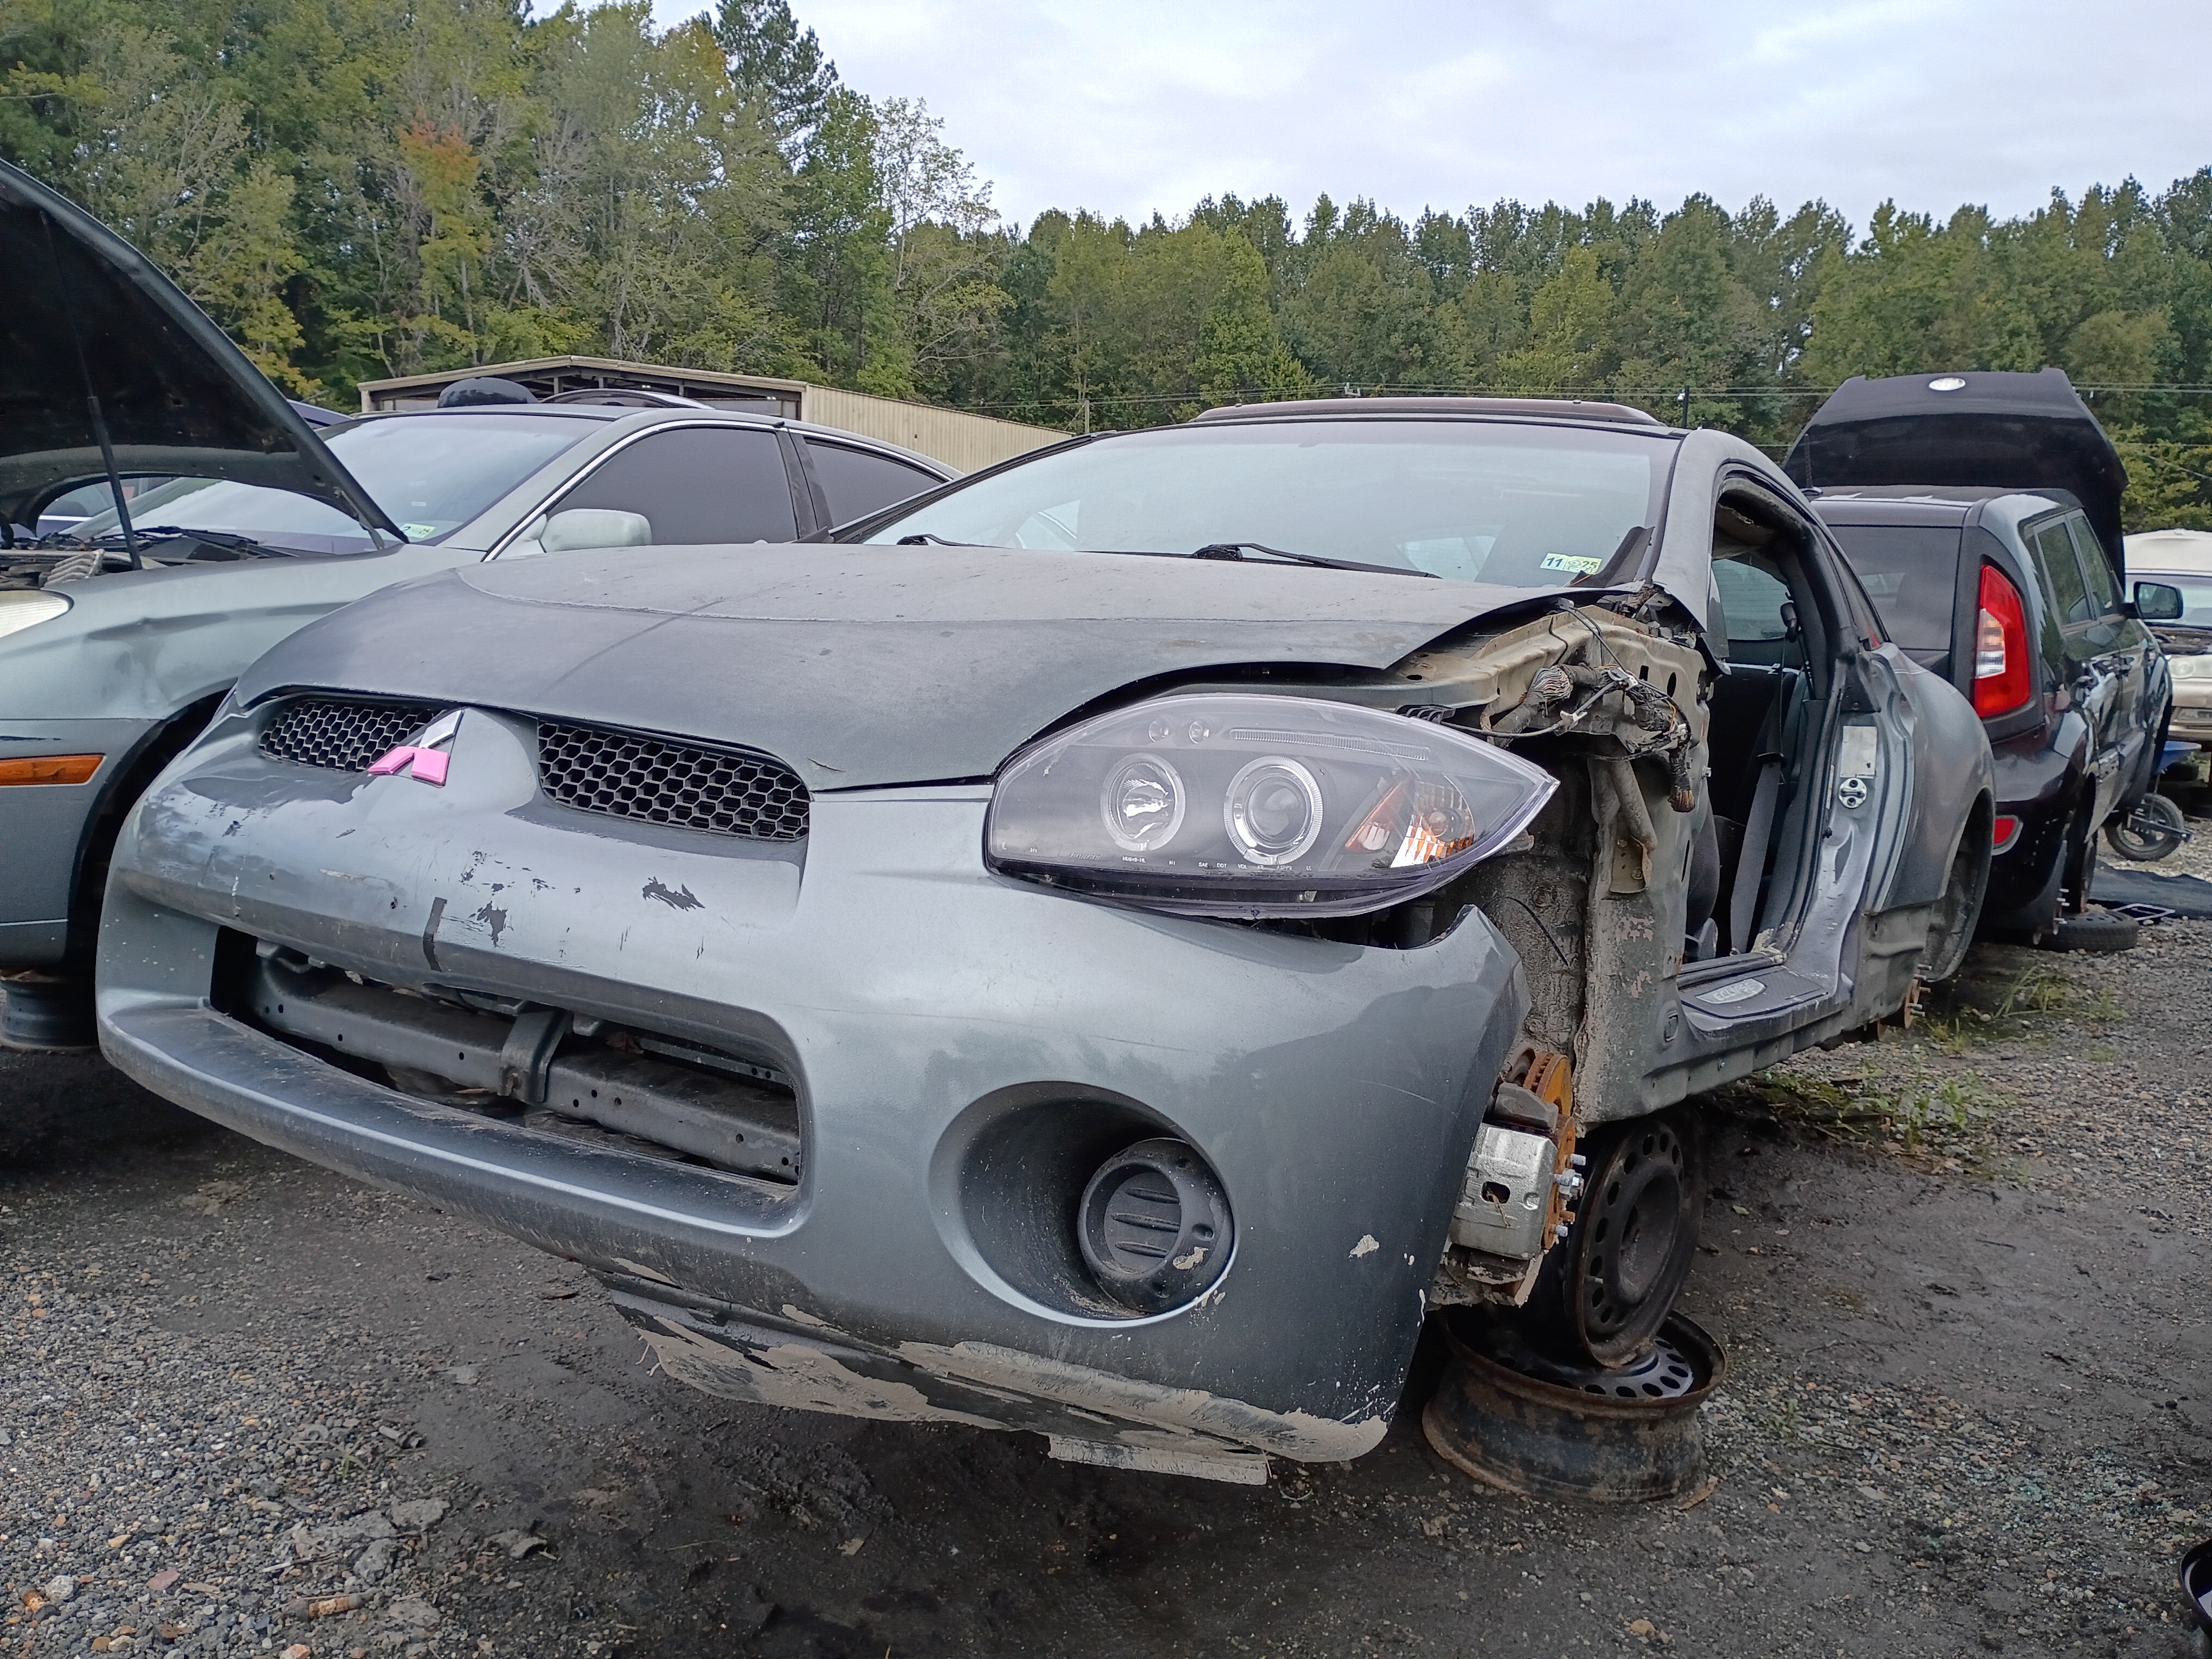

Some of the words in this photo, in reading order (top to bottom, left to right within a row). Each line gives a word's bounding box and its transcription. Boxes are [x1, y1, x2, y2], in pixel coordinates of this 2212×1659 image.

[1547, 557, 1564, 568] 11
[1581, 561, 1598, 569] 25
[1713, 982, 1756, 1001] ECLIPSE
